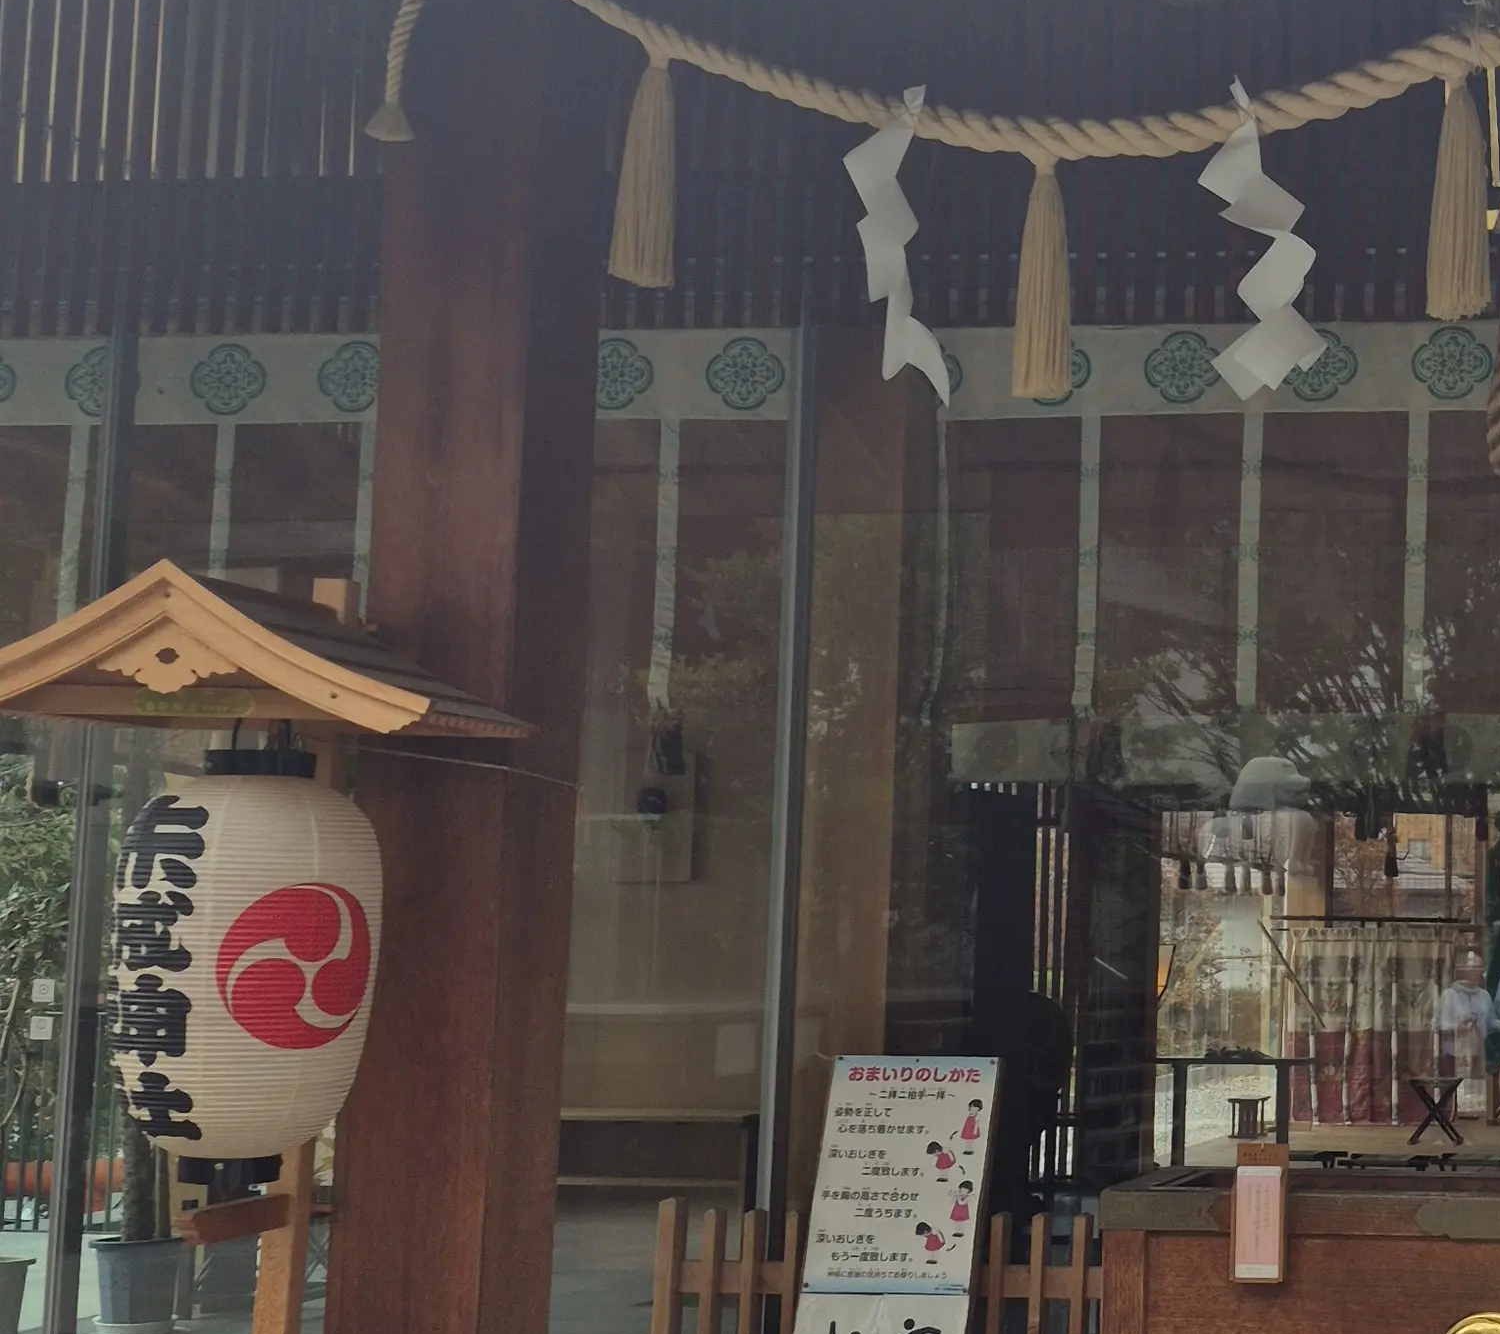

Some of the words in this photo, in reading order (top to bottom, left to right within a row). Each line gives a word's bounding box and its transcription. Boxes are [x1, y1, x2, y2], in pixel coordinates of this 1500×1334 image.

[848, 1066, 981, 1083] おまいりのしかた
[834, 1107, 893, 1117] 姿勢を正して
[837, 1125, 930, 1135] 心を落ち着かせます。
[828, 1149, 886, 1159] 深いおじぎを
[854, 1208, 917, 1218] 二度うちます。
[816, 1233, 875, 1244] 深いおじぎを
[831, 1251, 913, 1262] もう一度致します。
